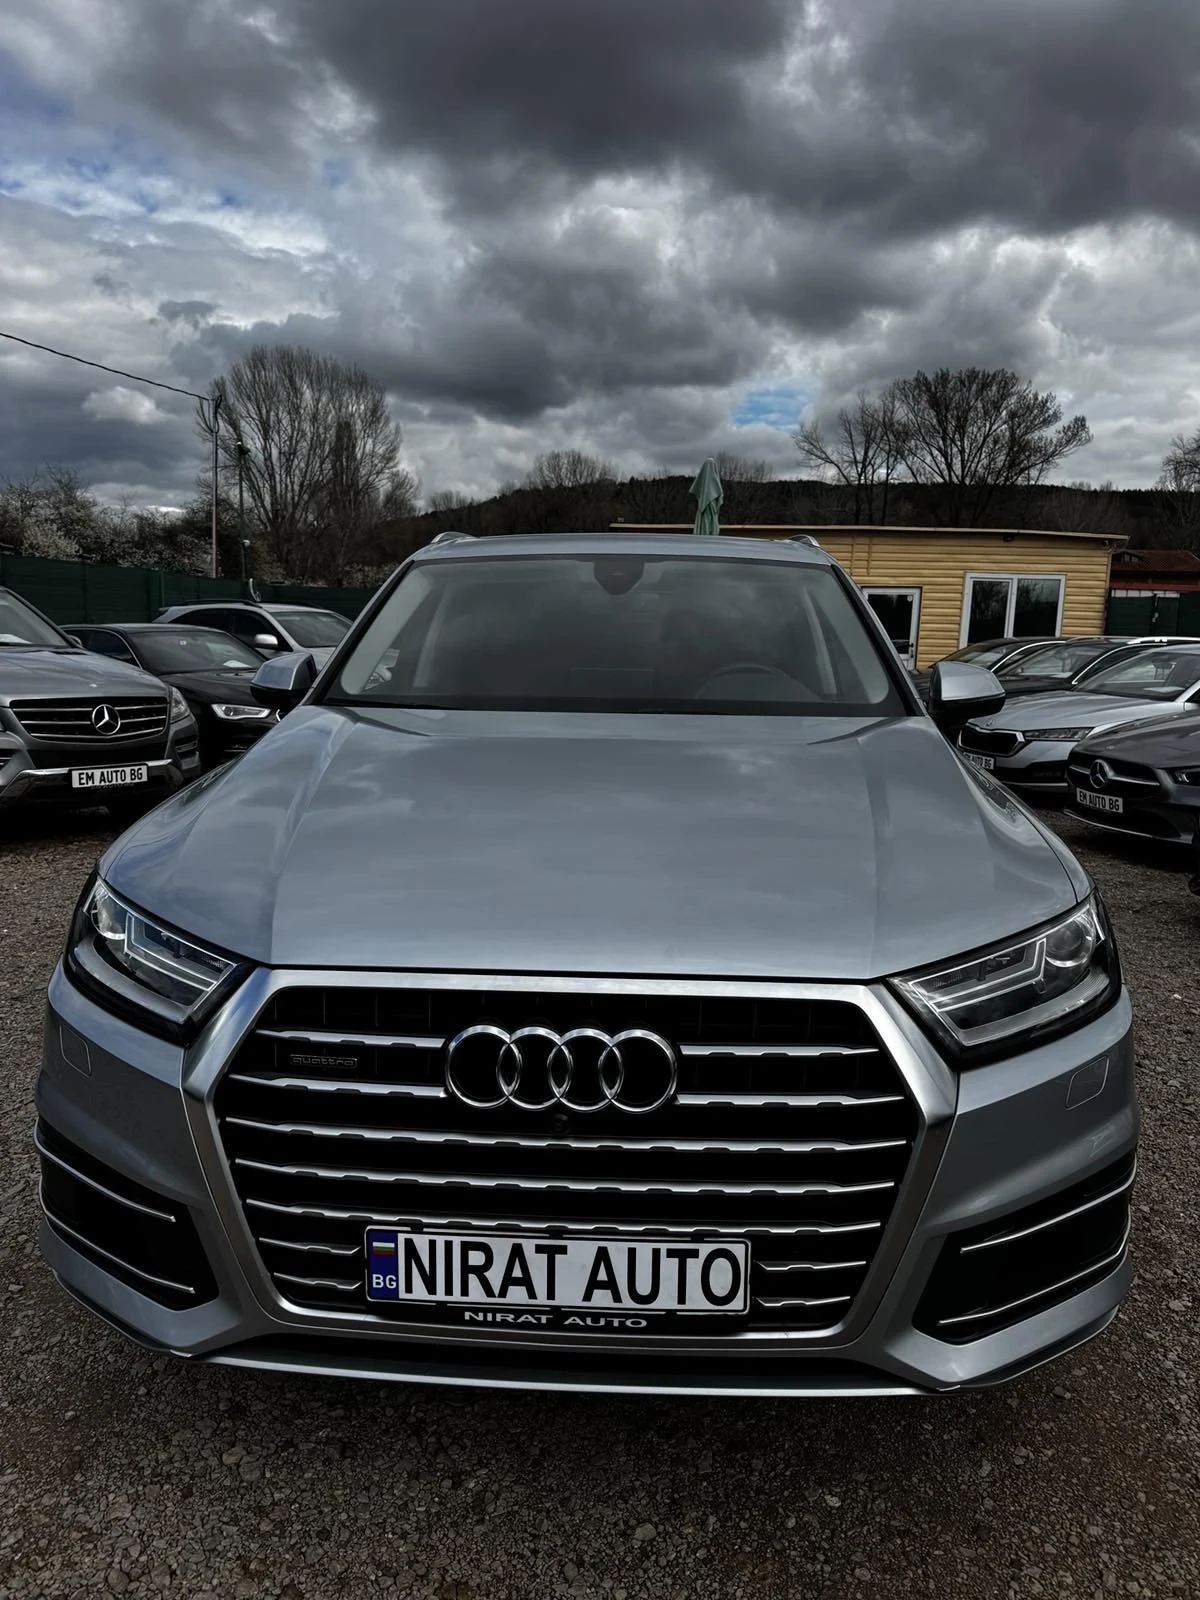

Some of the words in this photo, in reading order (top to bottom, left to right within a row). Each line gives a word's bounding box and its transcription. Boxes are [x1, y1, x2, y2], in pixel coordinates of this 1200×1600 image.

[78, 772, 95, 785] EM
[99, 769, 127, 784] AUTO
[130, 767, 143, 781] BG
[1089, 794, 1107, 809] AUTO
[1108, 798, 1120, 811] BG
[292, 1056, 355, 1066] quattro
[404, 1237, 568, 1301] NIRAT
[582, 1246, 742, 1307] AUTO
[372, 1273, 397, 1289] BG
[464, 1311, 553, 1325] NIRAT
[564, 1316, 648, 1328] AUTO
